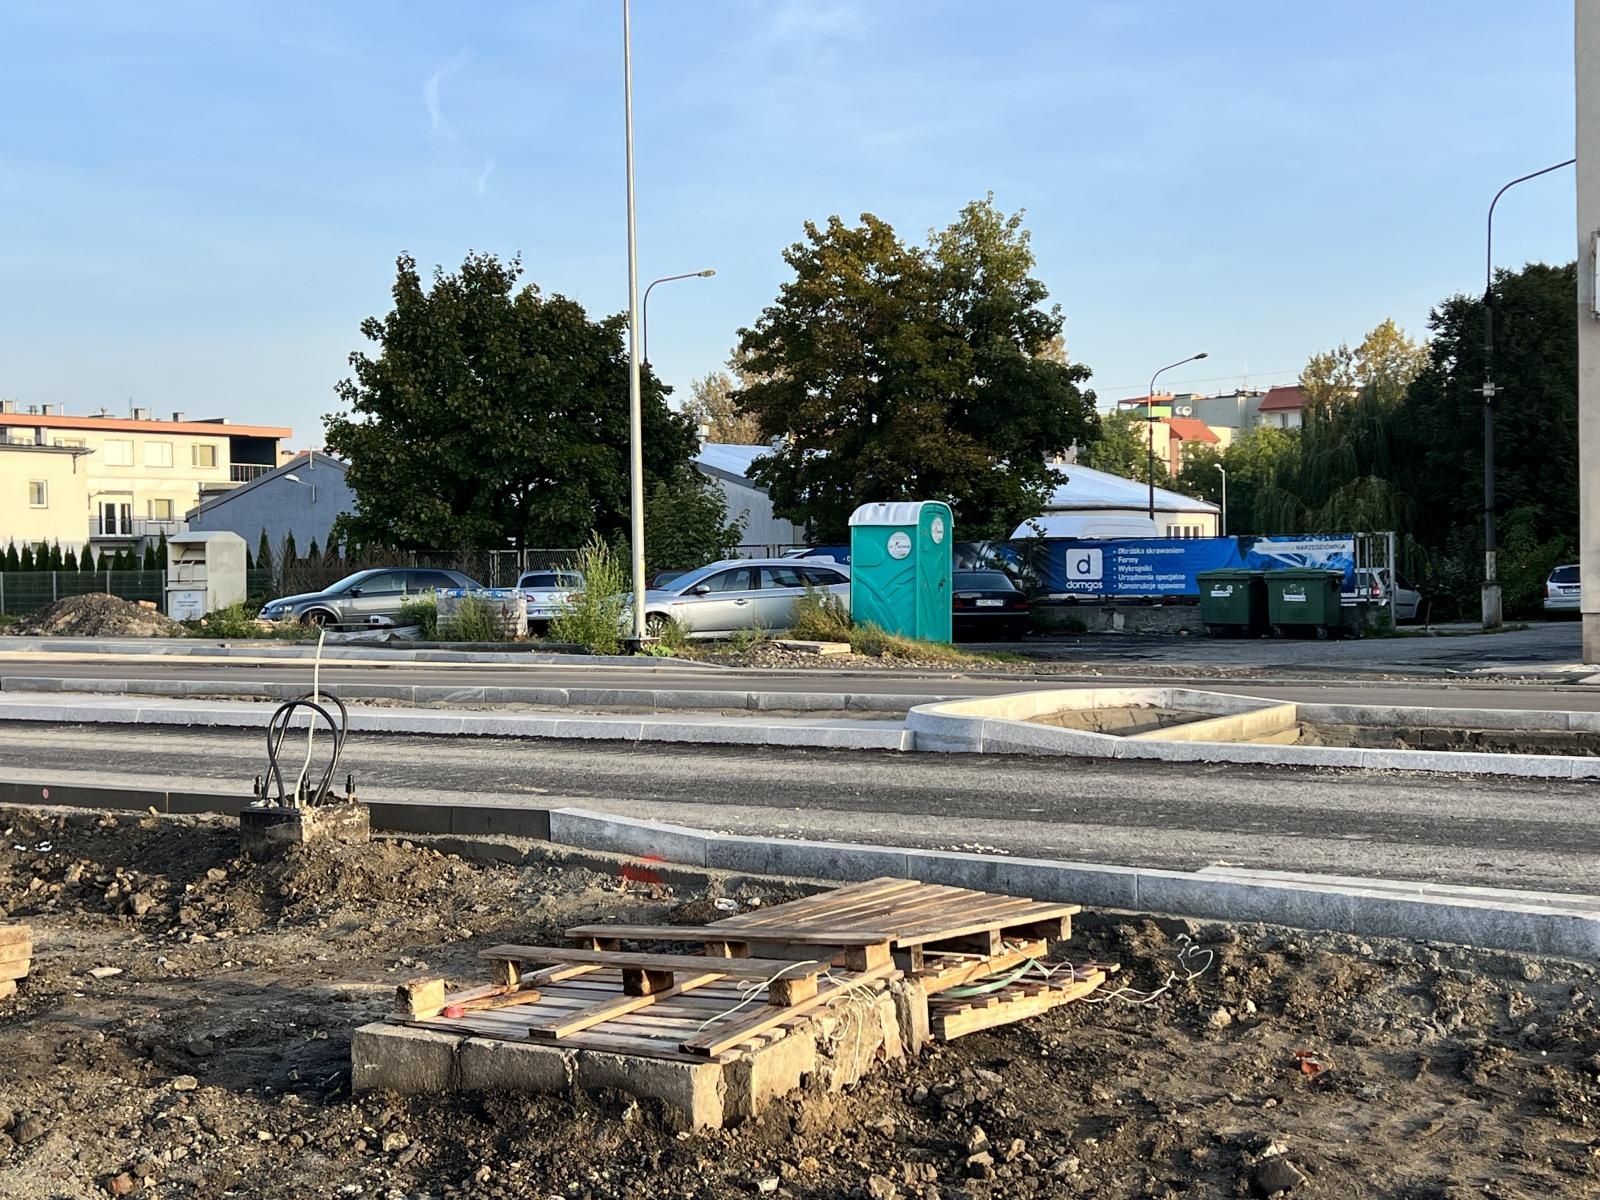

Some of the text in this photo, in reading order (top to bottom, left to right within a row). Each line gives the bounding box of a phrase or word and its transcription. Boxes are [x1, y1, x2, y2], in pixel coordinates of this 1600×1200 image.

[1118, 556, 1139, 564] Formy
[1156, 573, 1186, 581] specjalne
[1066, 581, 1103, 592] domgos
[1118, 582, 1156, 590] Konstrukcje
